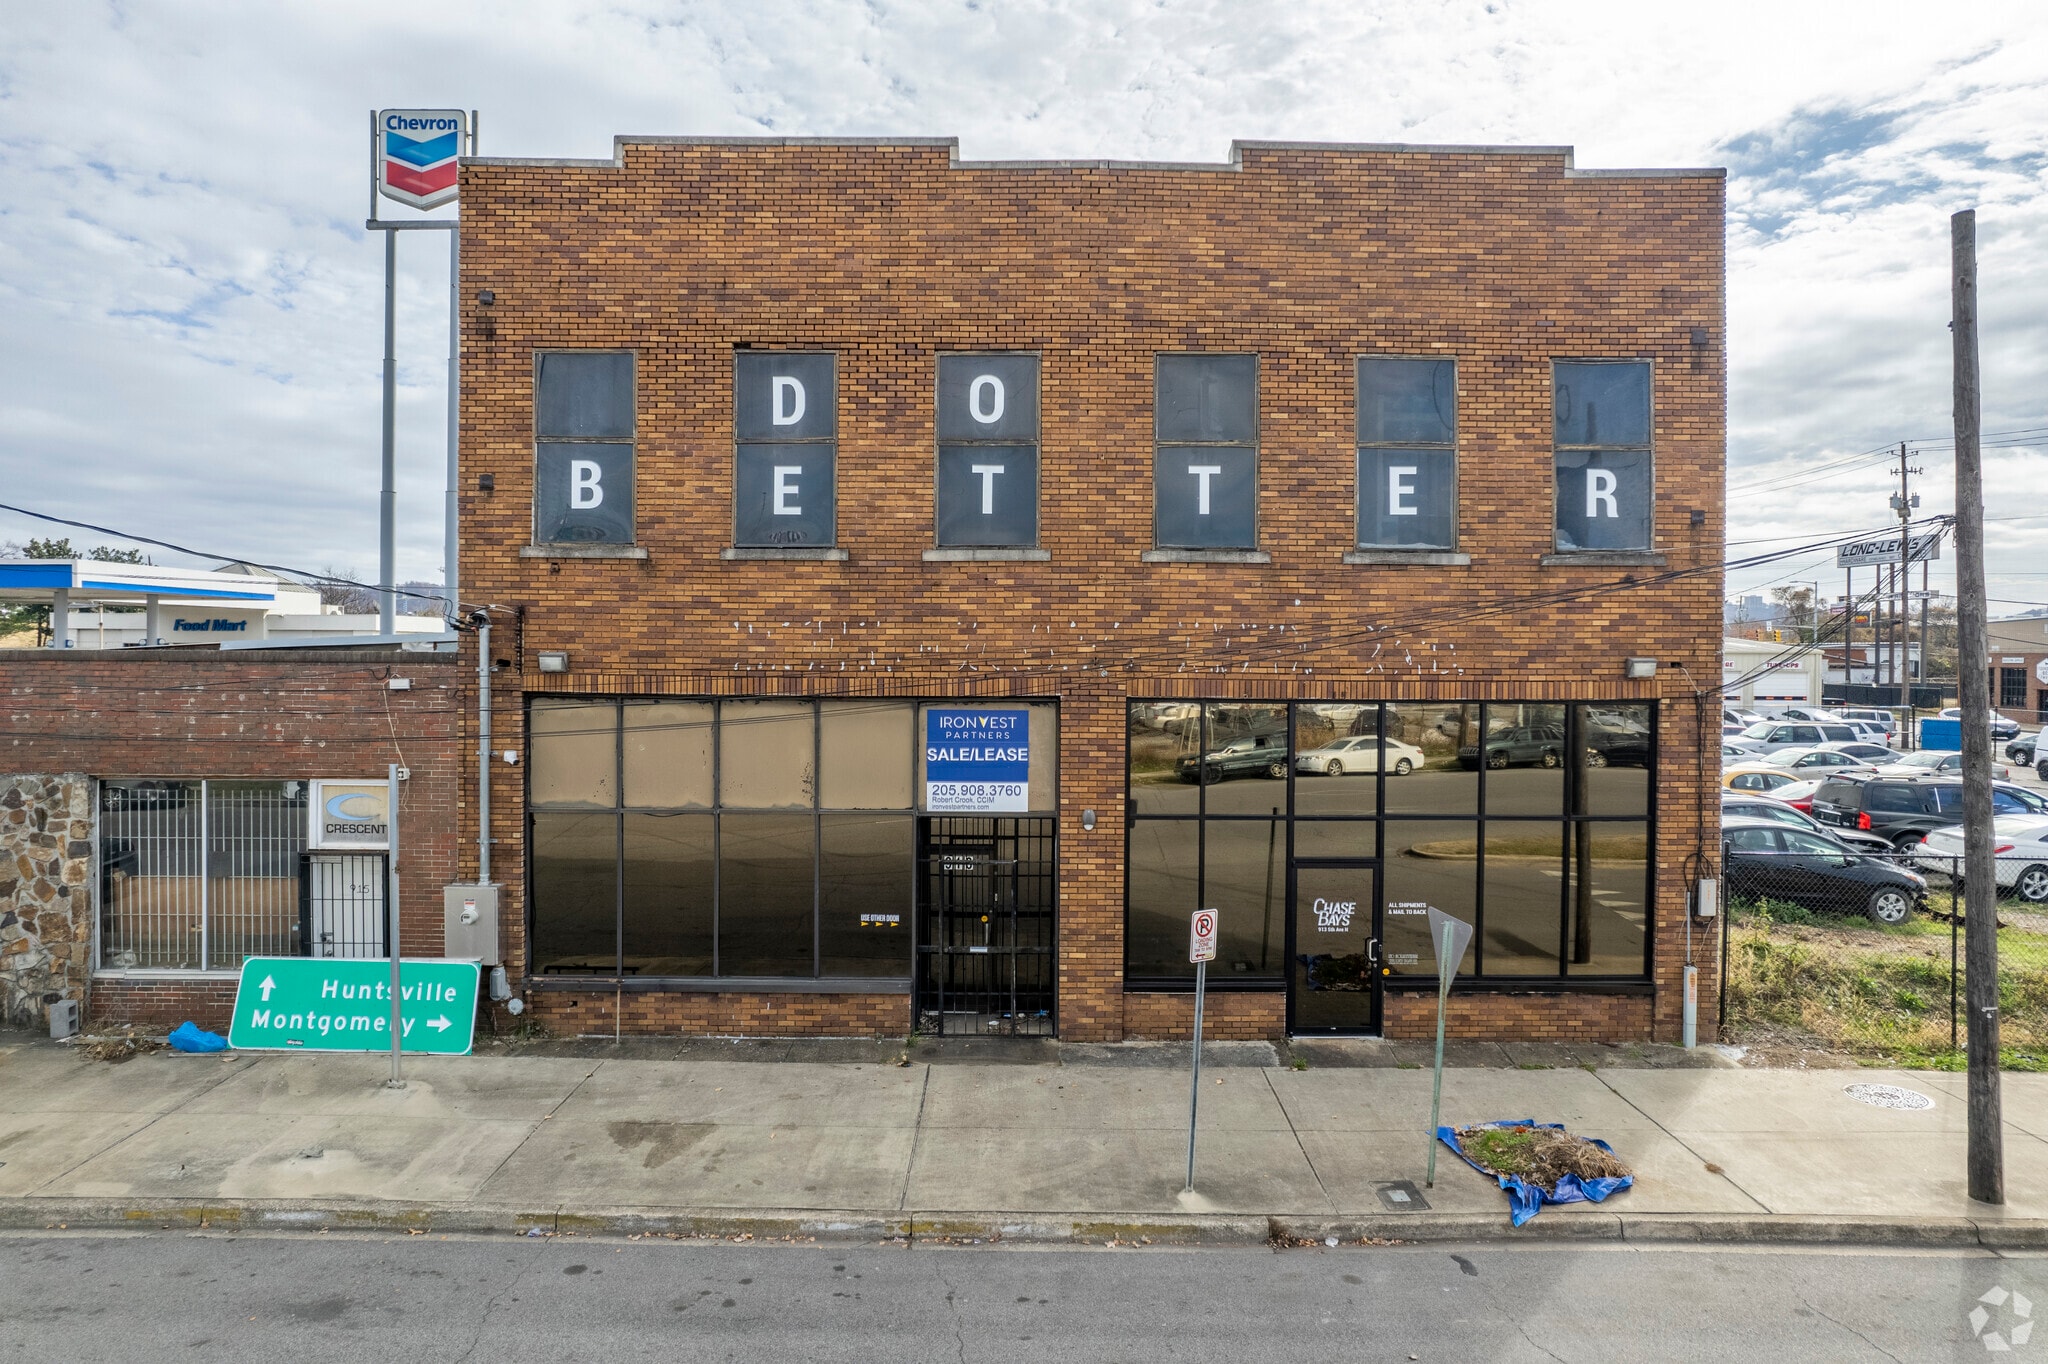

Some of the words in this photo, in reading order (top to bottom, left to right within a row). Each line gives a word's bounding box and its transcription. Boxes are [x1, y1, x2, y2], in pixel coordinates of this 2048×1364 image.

[386, 114, 458, 131] Chevron
[173, 618, 210, 631] Food
[212, 618, 247, 631] Mart
[939, 715, 1017, 729] IRONVEST
[945, 731, 1010, 740] PARTNERS
[927, 747, 1028, 762] SALE/LEASE
[932, 784, 1022, 796] 205.908.3760
[932, 796, 953, 804] Robert
[954, 796, 975, 804] Crook,
[326, 823, 387, 834] CRESCENT
[350, 884, 370, 894] 915
[1313, 898, 1356, 915] CHASE
[886, 914, 900, 922] DOOR
[1317, 911, 1351, 926] BAYS
[250, 1008, 416, 1037] Montgomey
